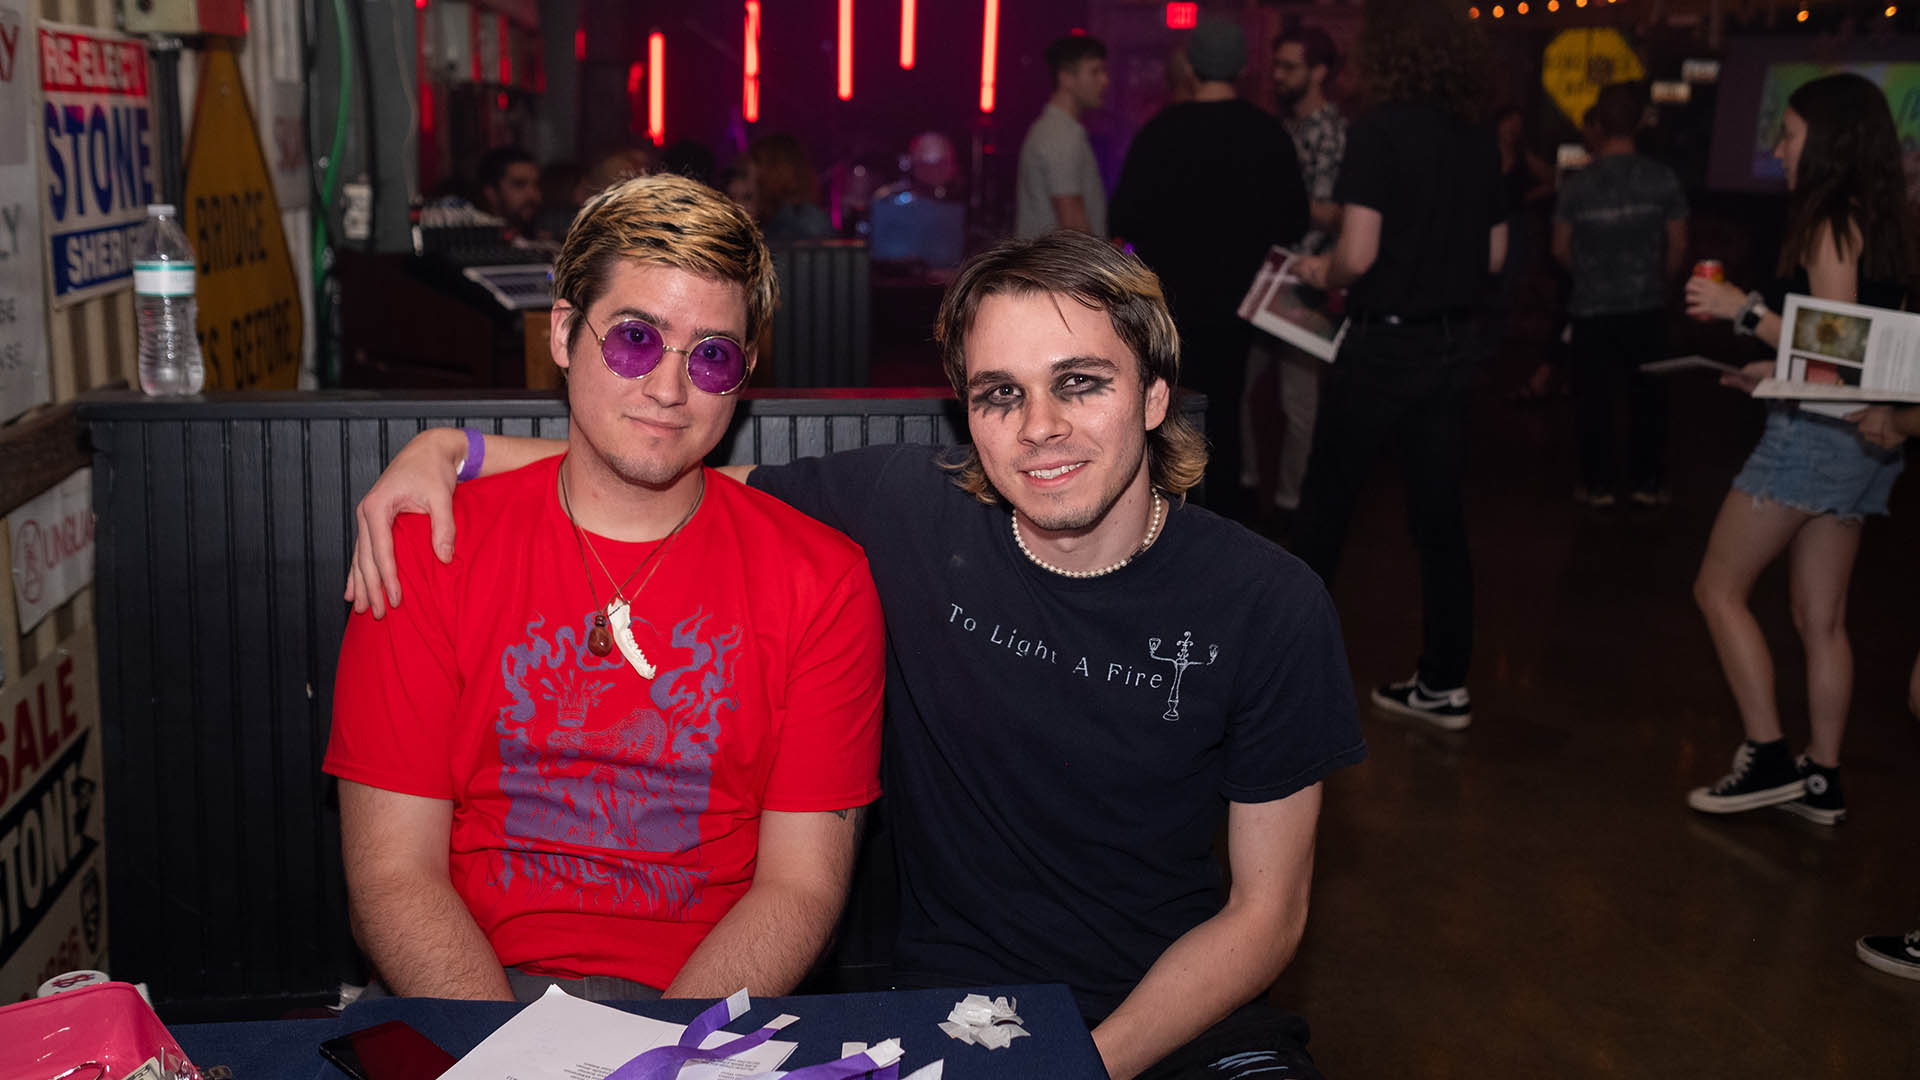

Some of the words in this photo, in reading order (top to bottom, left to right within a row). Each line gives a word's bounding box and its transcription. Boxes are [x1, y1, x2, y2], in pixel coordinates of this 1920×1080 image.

[42, 33, 143, 91] RE-ELECT
[44, 101, 153, 222] STONE
[196, 192, 268, 275] BRIDGE
[231, 298, 294, 389] BEFORE
[949, 603, 977, 632] To
[990, 624, 1057, 663] Light
[1072, 656, 1089, 678] A
[1107, 662, 1163, 690] Fire
[0, 763, 85, 942] TONE
